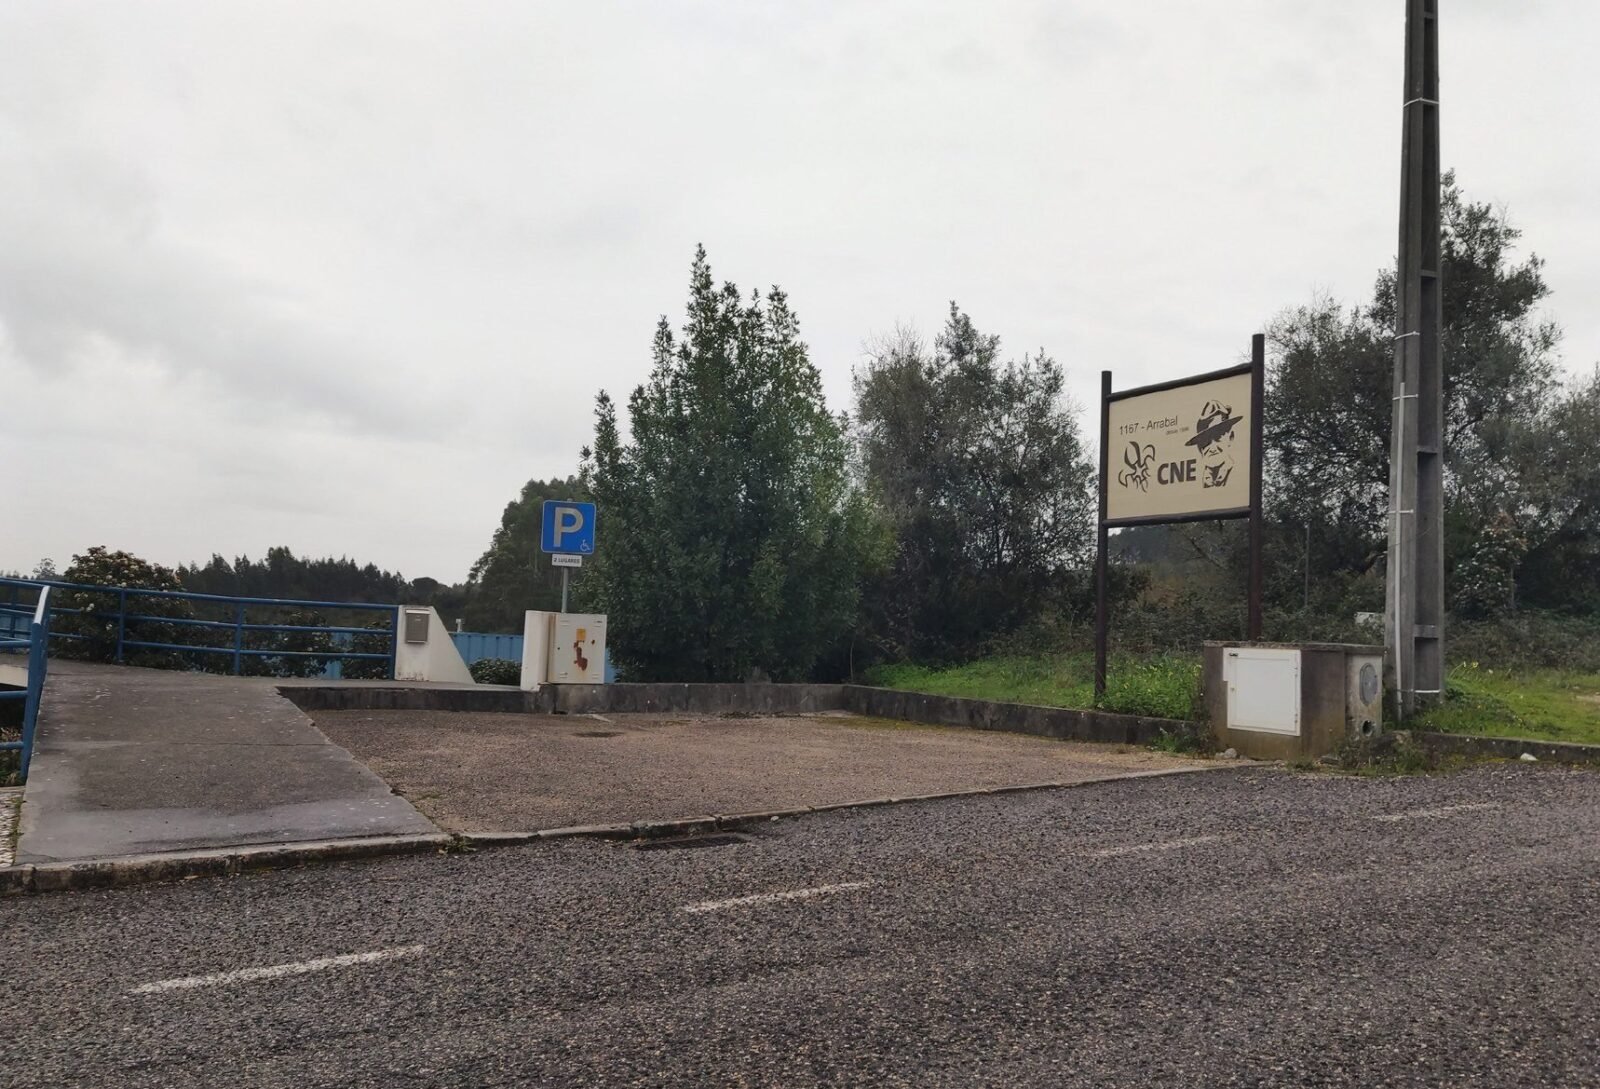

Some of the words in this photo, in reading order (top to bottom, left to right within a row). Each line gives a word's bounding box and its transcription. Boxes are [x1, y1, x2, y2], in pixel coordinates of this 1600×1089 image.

[1119, 422, 1139, 435] 1167
[1146, 415, 1178, 430] Arrabal
[1157, 459, 1197, 485] CNE
[553, 507, 583, 547] P
